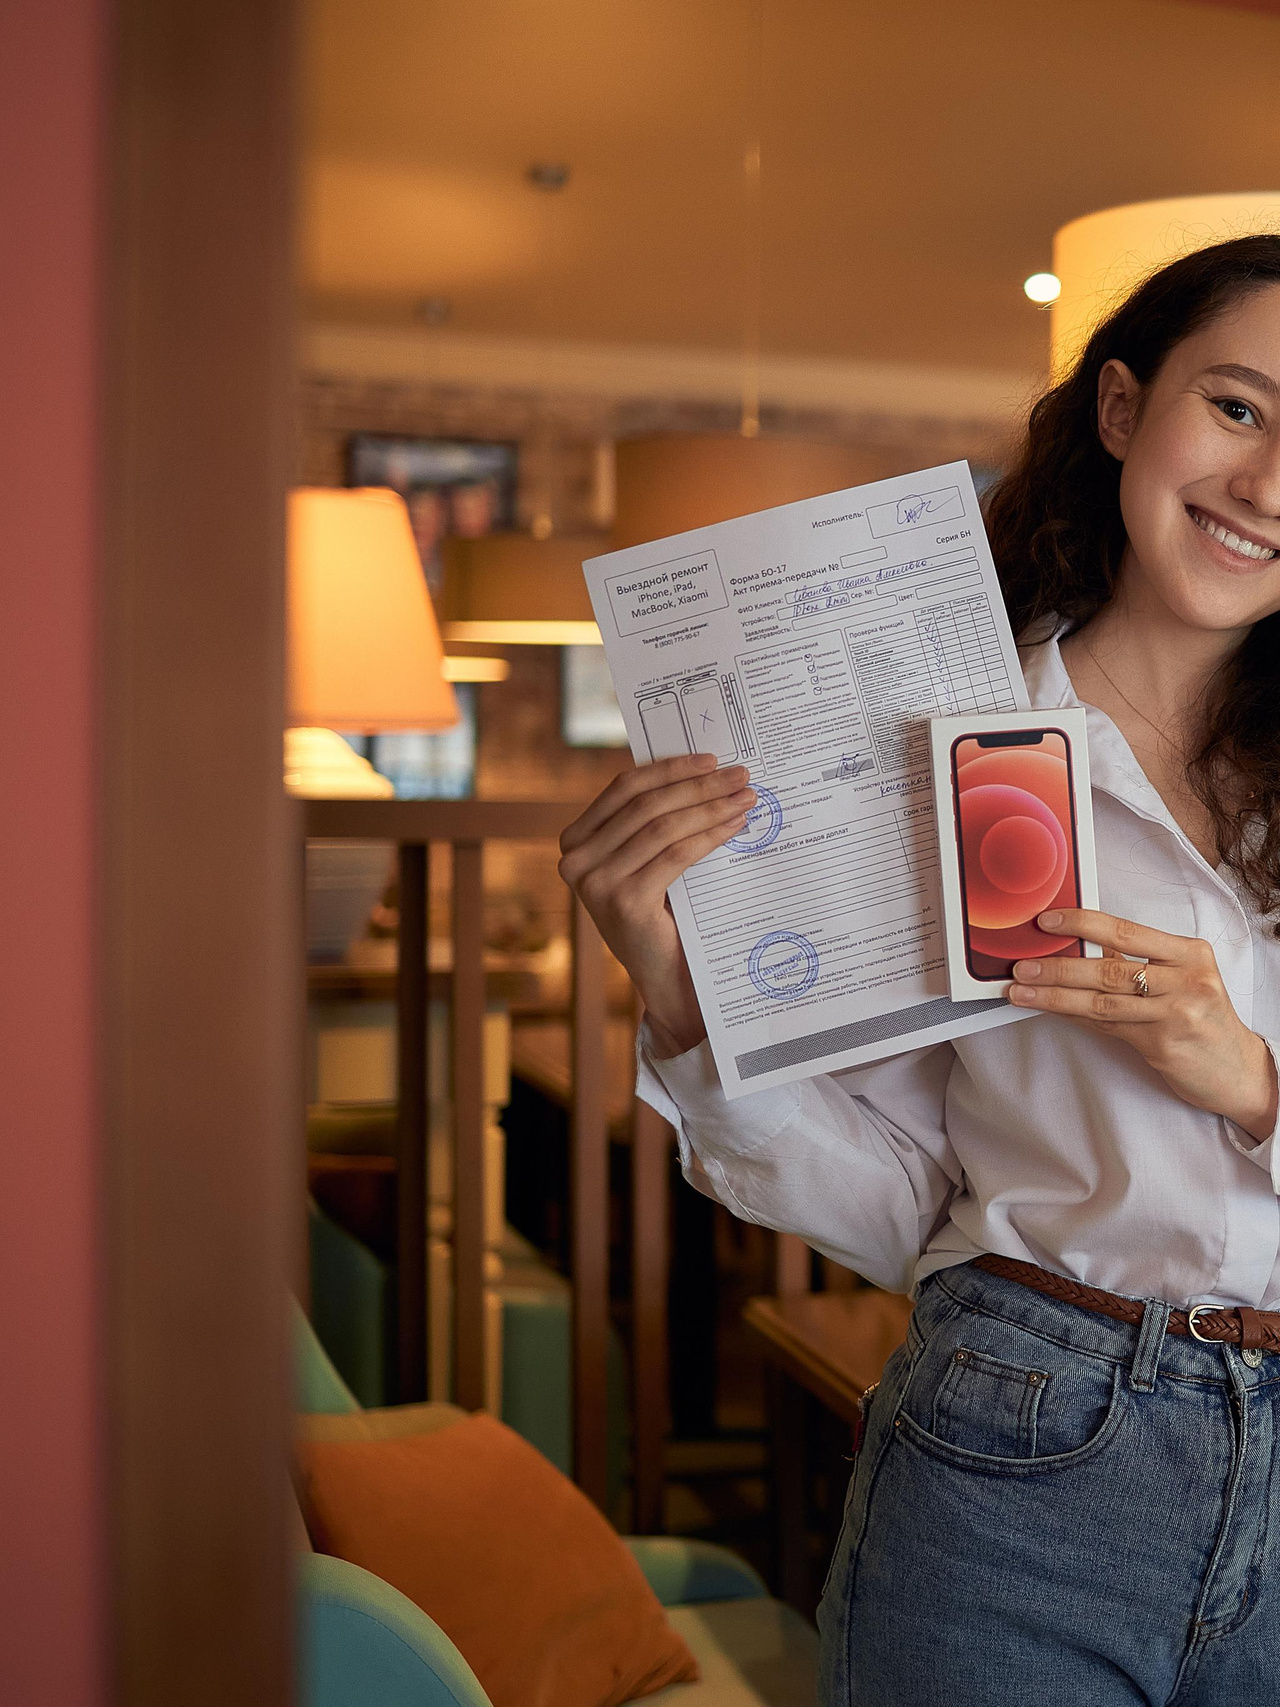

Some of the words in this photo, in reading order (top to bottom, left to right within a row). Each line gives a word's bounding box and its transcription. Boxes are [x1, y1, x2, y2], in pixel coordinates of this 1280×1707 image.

[812, 511, 864, 528] Исполнитель:
[936, 534, 959, 544] Серия
[960, 530, 971, 538] БН
[616, 573, 669, 595] Выездной
[671, 563, 708, 582] ремонт
[730, 573, 759, 585] Форма
[761, 564, 786, 578] БО-17
[733, 587, 747, 596] Акт
[749, 567, 827, 592] приема-передачи
[828, 563, 839, 571] №
[637, 589, 672, 603] iPhone,
[673, 580, 696, 593] iPad,
[631, 600, 676, 618] MacBook,
[677, 590, 708, 605] Xiaomi
[738, 605, 753, 614] ФИО
[754, 598, 784, 610] Клиента:
[849, 628, 878, 639] Проверка
[879, 620, 904, 631] функций
[741, 652, 780, 666] Гарантийные
[781, 642, 818, 655] примечания
[903, 808, 919, 817] Срок
[729, 847, 778, 864] Наименование
[779, 841, 798, 852] работ
[805, 835, 825, 844] видов
[826, 828, 848, 839] доплат
